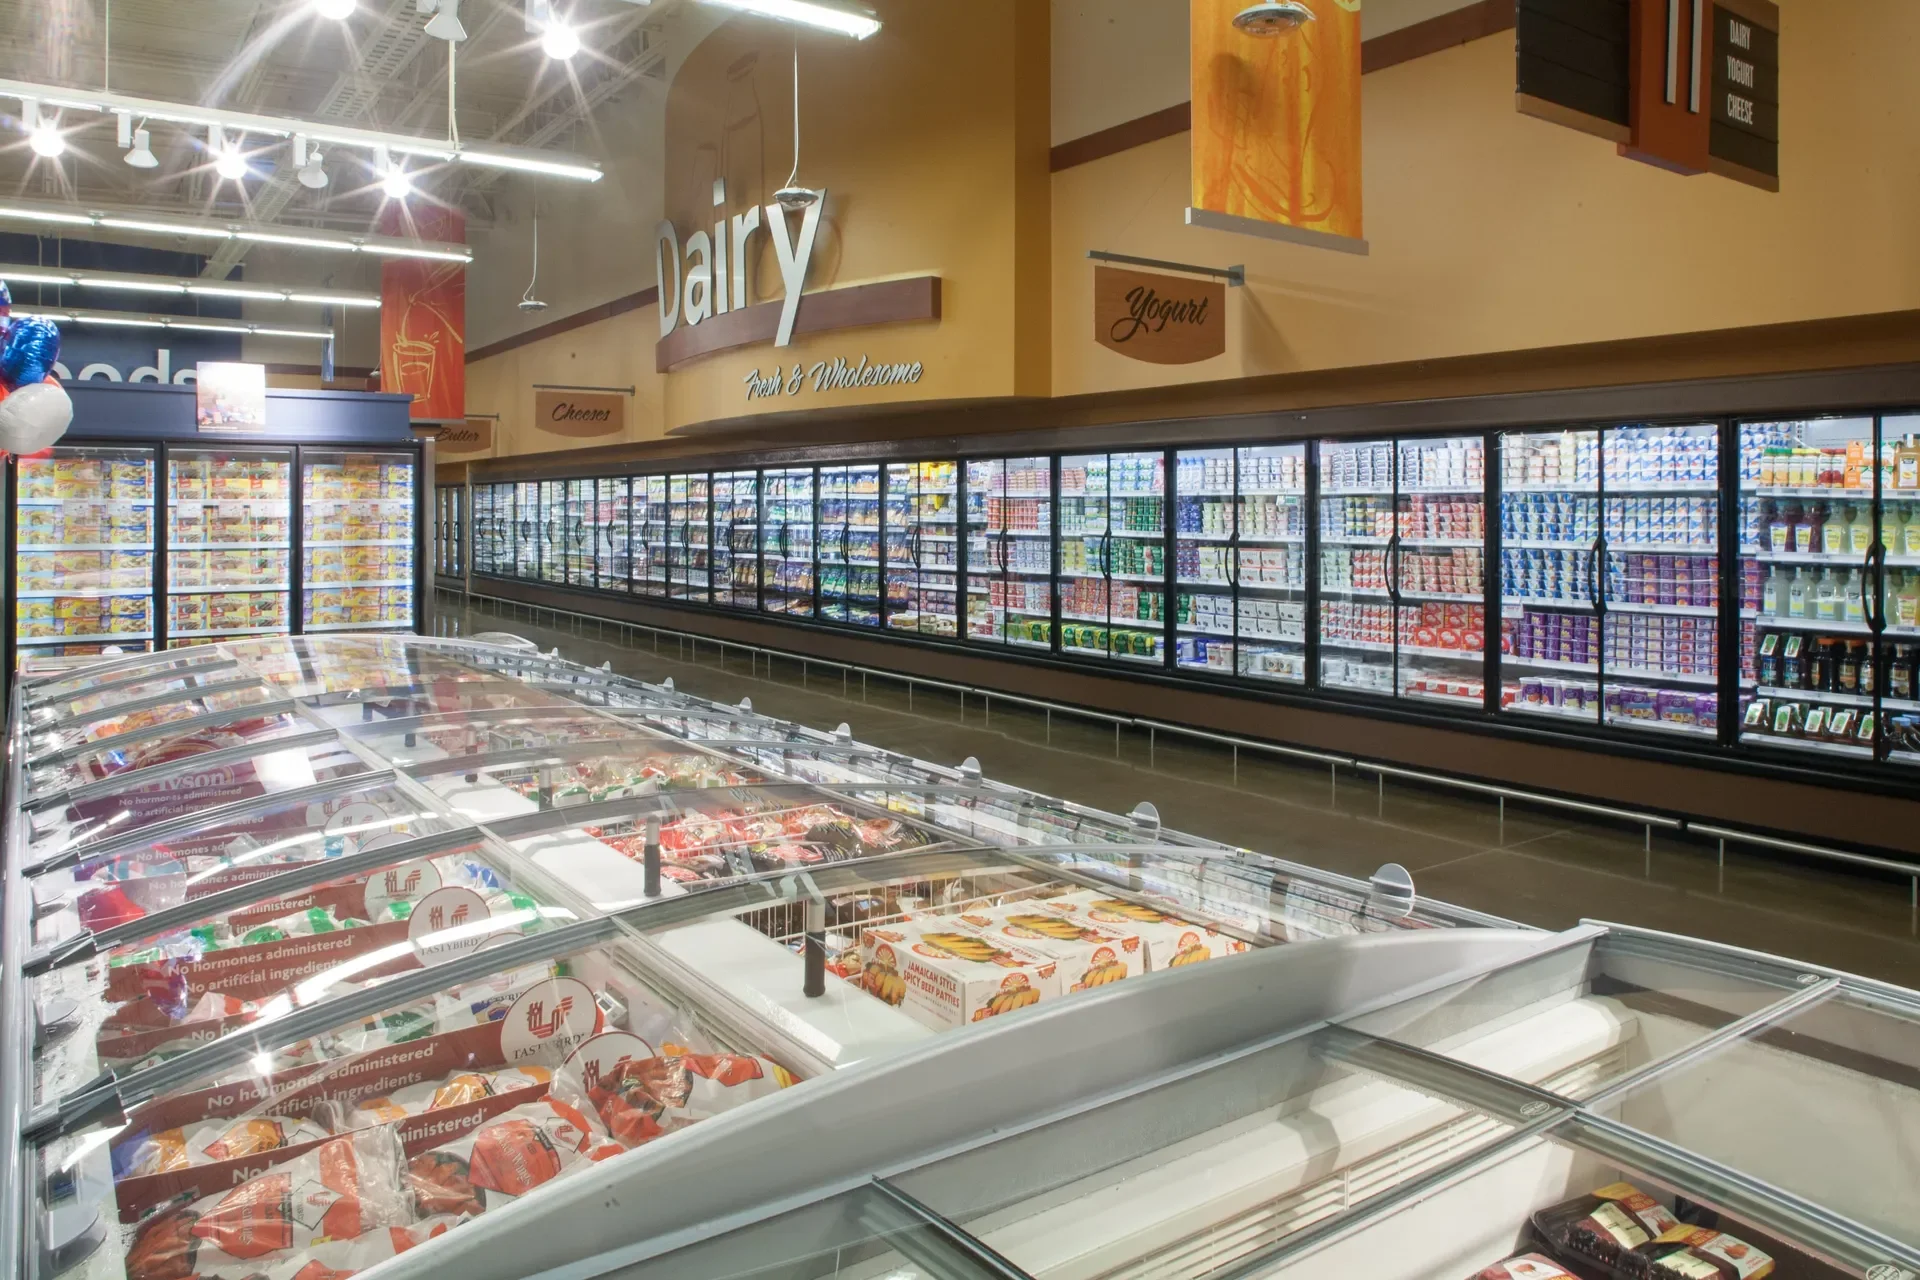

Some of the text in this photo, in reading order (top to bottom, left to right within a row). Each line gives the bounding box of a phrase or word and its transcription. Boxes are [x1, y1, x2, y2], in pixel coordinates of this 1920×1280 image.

[1730, 19, 1751, 50] DAIRY
[1727, 55, 1754, 88] YOGURT
[1727, 93, 1753, 125] CHEESE
[656, 176, 827, 347] Dairy
[1110, 286, 1209, 343] Yogurt
[743, 352, 924, 400] Fresh & Wholesome
[551, 402, 612, 422] Cheeses
[435, 427, 480, 442] Butter
[119, 798, 133, 807] No
[135, 793, 182, 805] hormones
[145, 804, 184, 817] artificial
[135, 852, 153, 863] No
[155, 845, 209, 861] hormones
[168, 964, 190, 977] No
[193, 952, 263, 973] hormones
[907, 960, 957, 993] JAMAICAN STYLE
[208, 970, 267, 992] artificial
[903, 969, 921, 988] SPICY
[920, 980, 935, 995] BEEF
[935, 988, 960, 1009] PATTIES
[191, 1029, 217, 1042] No
[208, 1095, 234, 1110] No
[239, 1071, 325, 1102] hormones
[330, 1070, 422, 1099] ingredients
[232, 1165, 262, 1184] No
